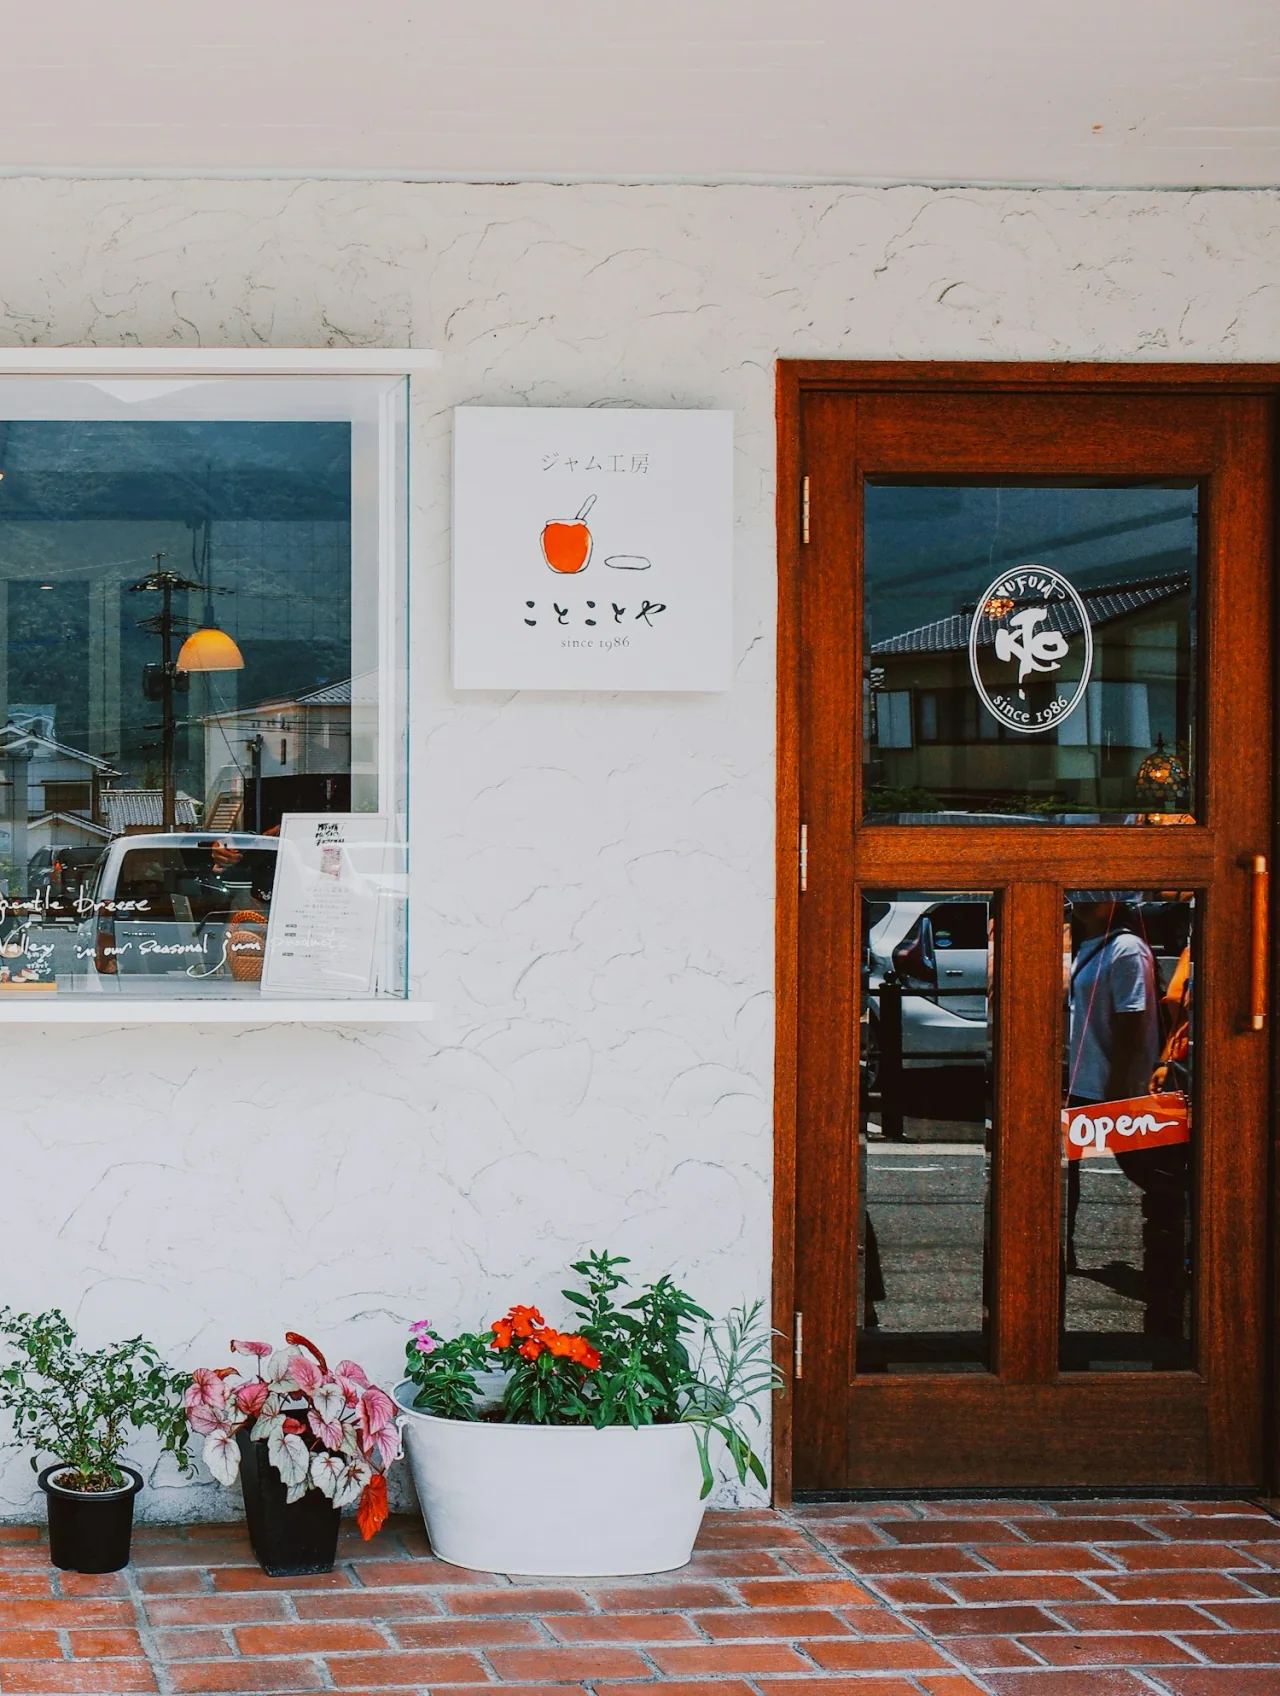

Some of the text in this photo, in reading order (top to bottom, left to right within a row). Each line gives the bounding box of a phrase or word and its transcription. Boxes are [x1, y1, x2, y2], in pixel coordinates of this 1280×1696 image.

[541, 453, 649, 474] ジャム工房
[524, 600, 667, 627] ことことや
[560, 636, 630, 652] since 1986
[992, 694, 1068, 723] since 1986
[104, 943, 131, 956] our
[1069, 1113, 1179, 1152] Open
